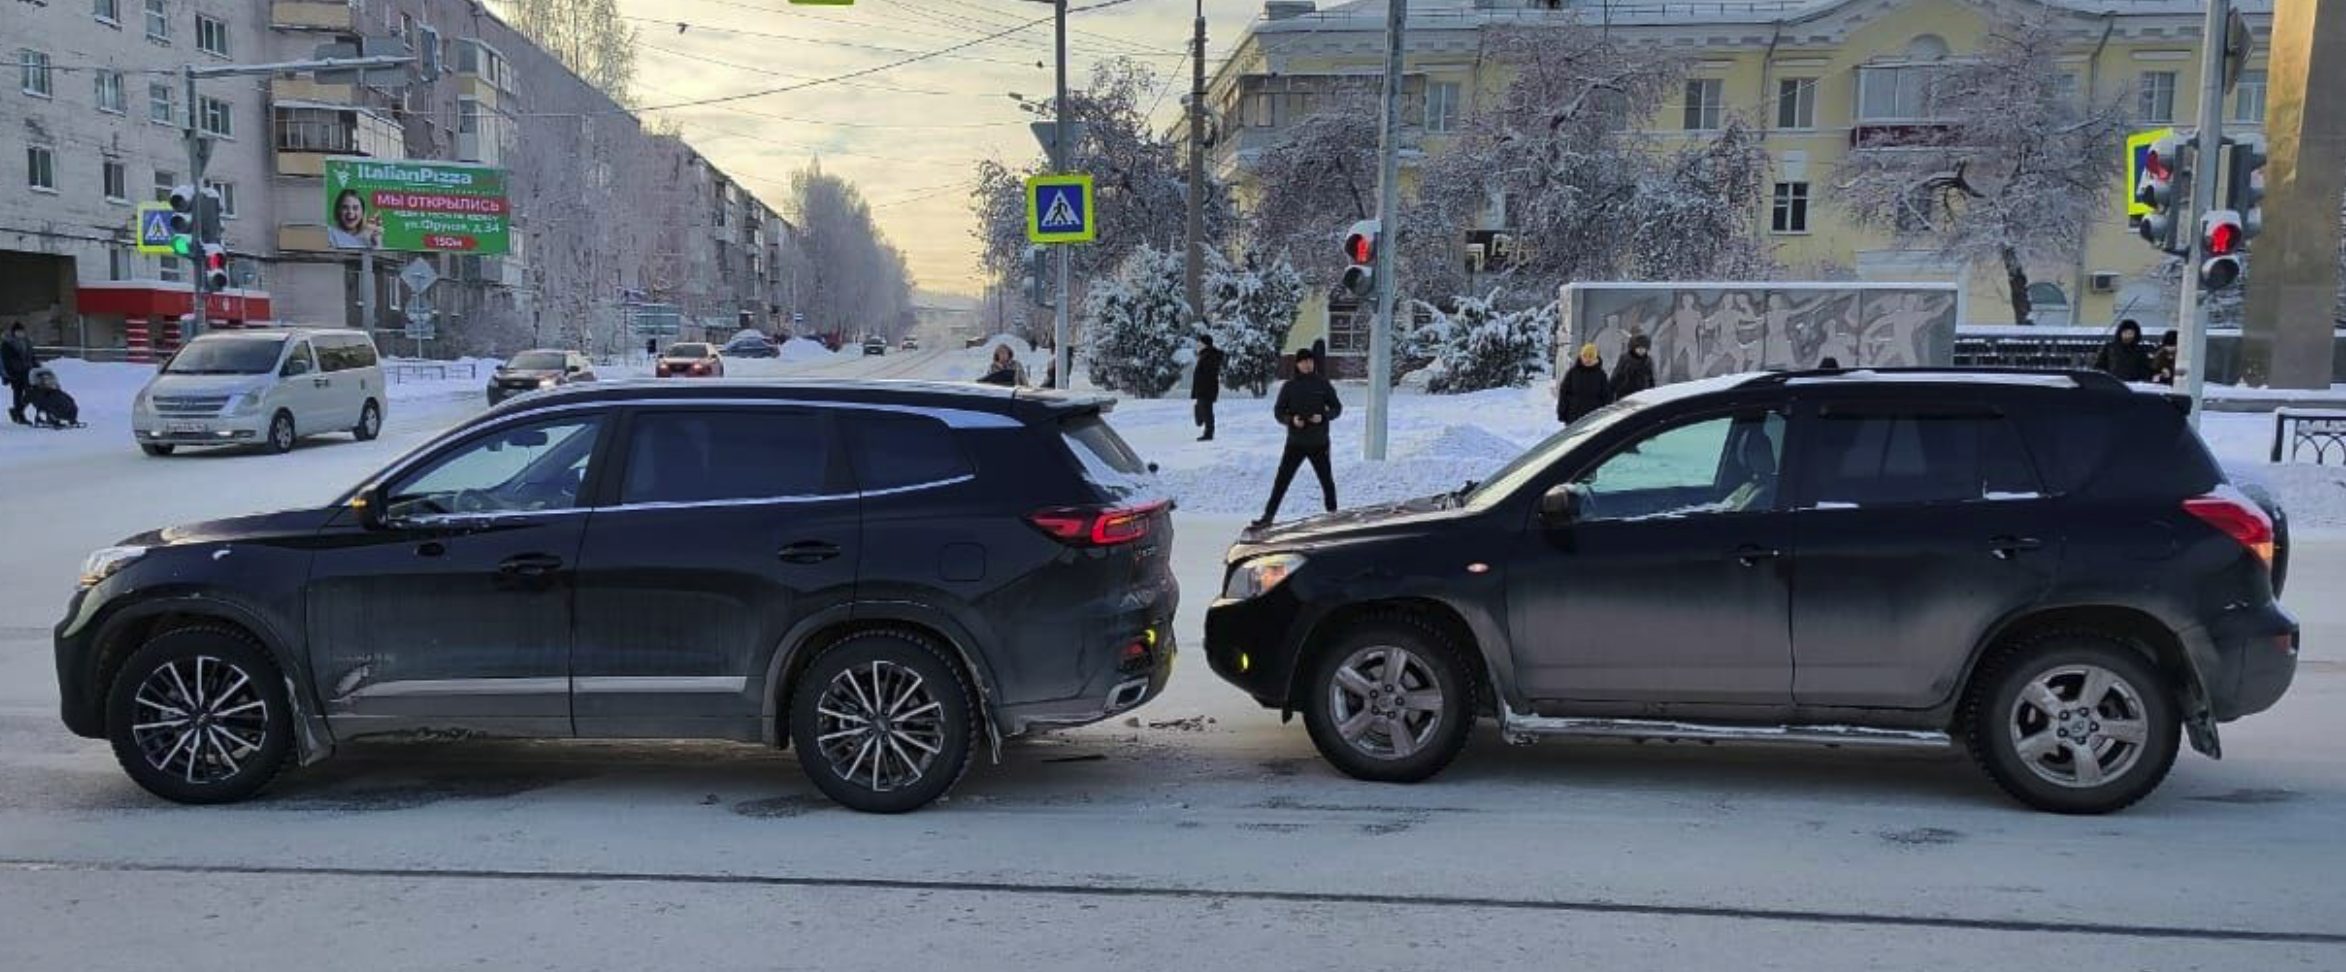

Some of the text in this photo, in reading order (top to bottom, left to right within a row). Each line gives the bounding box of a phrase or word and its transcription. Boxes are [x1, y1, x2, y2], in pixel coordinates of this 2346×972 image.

[377, 194, 500, 212] МЫ ОТКРЫЛИСЬ
[434, 237, 462, 247] 150м
